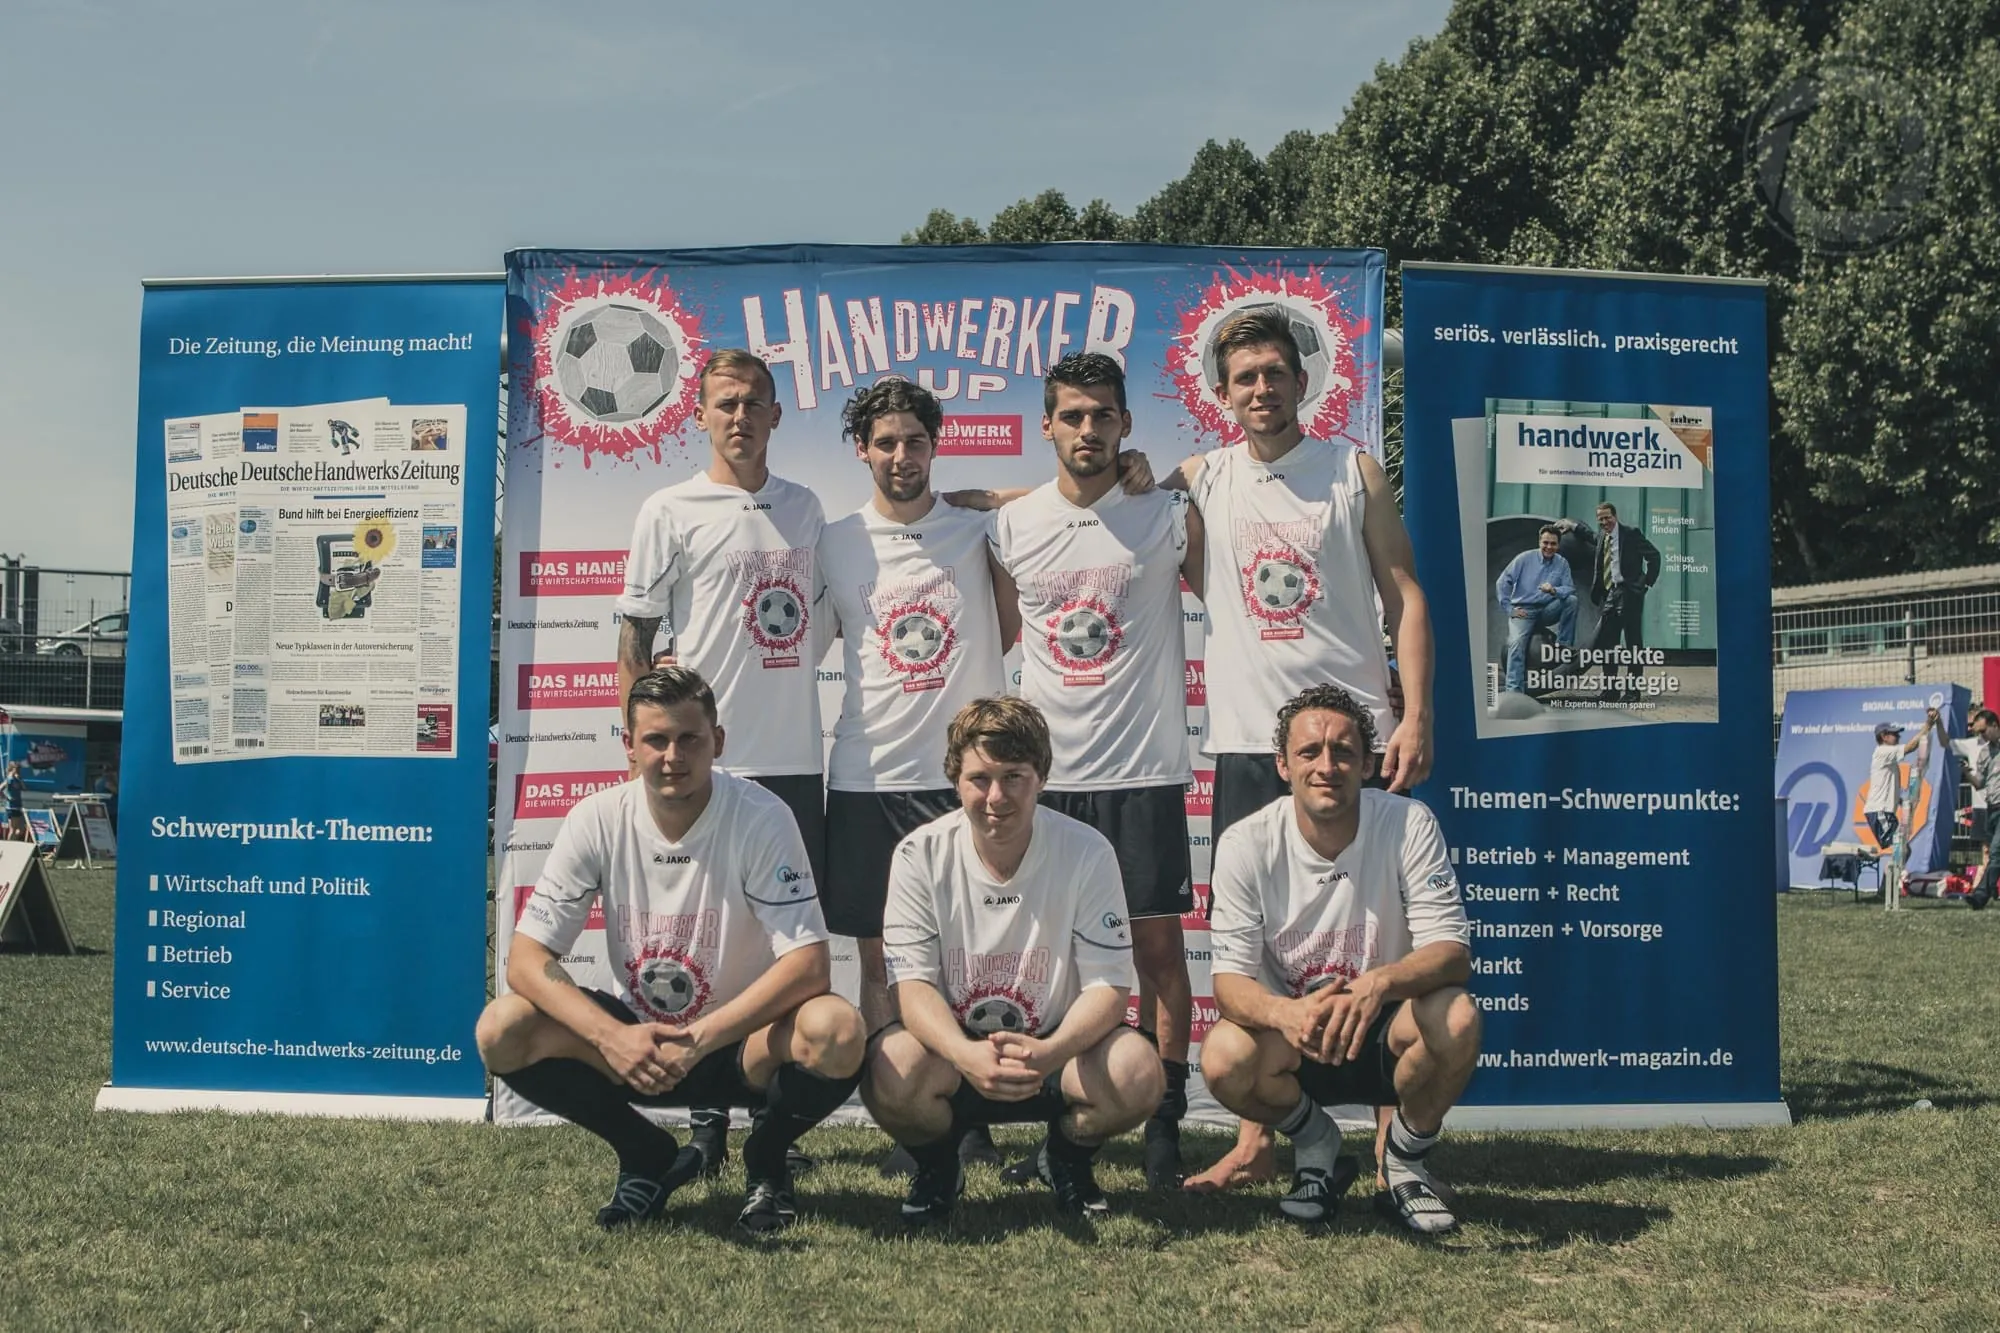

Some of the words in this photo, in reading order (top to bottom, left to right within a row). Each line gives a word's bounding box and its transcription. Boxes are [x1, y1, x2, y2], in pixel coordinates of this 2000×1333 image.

[169, 337, 201, 355] Die
[205, 336, 281, 358] Zeitung,
[287, 336, 316, 353] die
[320, 335, 405, 356] Meinung
[408, 332, 473, 352] macht!
[742, 285, 1136, 410] HANDWERKER
[1434, 323, 1496, 344] seriös.
[1502, 327, 1607, 349] verlässlich.
[1614, 332, 1739, 355] praxisgerecht
[876, 368, 1008, 401] UP
[1518, 422, 1661, 451] handwerk
[1588, 447, 1682, 473] magazin
[169, 466, 238, 492] Deutsche
[241, 460, 313, 481] Deutsche
[314, 459, 400, 481] Handwerks
[400, 459, 460, 486] Zeitung
[1265, 473, 1285, 483] JAKO
[279, 508, 303, 519] Bund
[306, 508, 324, 519] hilft
[327, 508, 342, 519] bei
[343, 507, 419, 521] Energieeffizienz
[1078, 519, 1099, 527] JAKO
[1665, 554, 1695, 563] Schluss
[531, 562, 568, 576] DAS
[531, 577, 543, 585] DIE
[276, 642, 294, 650] Neue
[295, 641, 332, 652] Typklassen
[333, 641, 339, 650] in
[341, 641, 352, 650] der
[354, 641, 414, 652] Autoversicherung
[1540, 643, 1571, 663] Die
[1580, 645, 1665, 668] perfekte
[529, 675, 566, 688] DAS
[1527, 669, 1679, 696] Bilanzstrategie
[529, 690, 540, 698] DIE
[544, 689, 620, 698] WIRTSCHAFTSMACH
[1550, 700, 1563, 708] Mit
[1564, 700, 1597, 709] Experten
[1598, 700, 1628, 709] Steuern
[526, 784, 564, 798] DAS
[525, 800, 539, 808] DIE
[1450, 787, 1740, 815] Themen-Schwerpunkte:
[151, 816, 433, 845] Schwerpunkt-Themen:
[665, 856, 692, 864] JAKO
[1466, 846, 1537, 866] Betrieb
[1544, 850, 1556, 863] +
[1563, 847, 1690, 869] Management
[164, 874, 264, 894] Wirtschaft
[269, 877, 305, 894] und
[311, 877, 371, 896] Politik
[1465, 884, 1540, 901] Steuern
[1547, 887, 1559, 899] +
[1567, 884, 1620, 902] Recht
[996, 895, 1020, 904] JAKO
[162, 909, 246, 933] Regional
[1466, 920, 1554, 938] Finanzen
[1561, 924, 1574, 936] +
[1580, 920, 1663, 942] Vorsorge
[163, 945, 232, 964] Betrieb
[1470, 957, 1523, 975] Markt
[161, 981, 231, 1000] Service
[145, 1037, 462, 1064] www.deutsche-handwerks-zeitung.de
